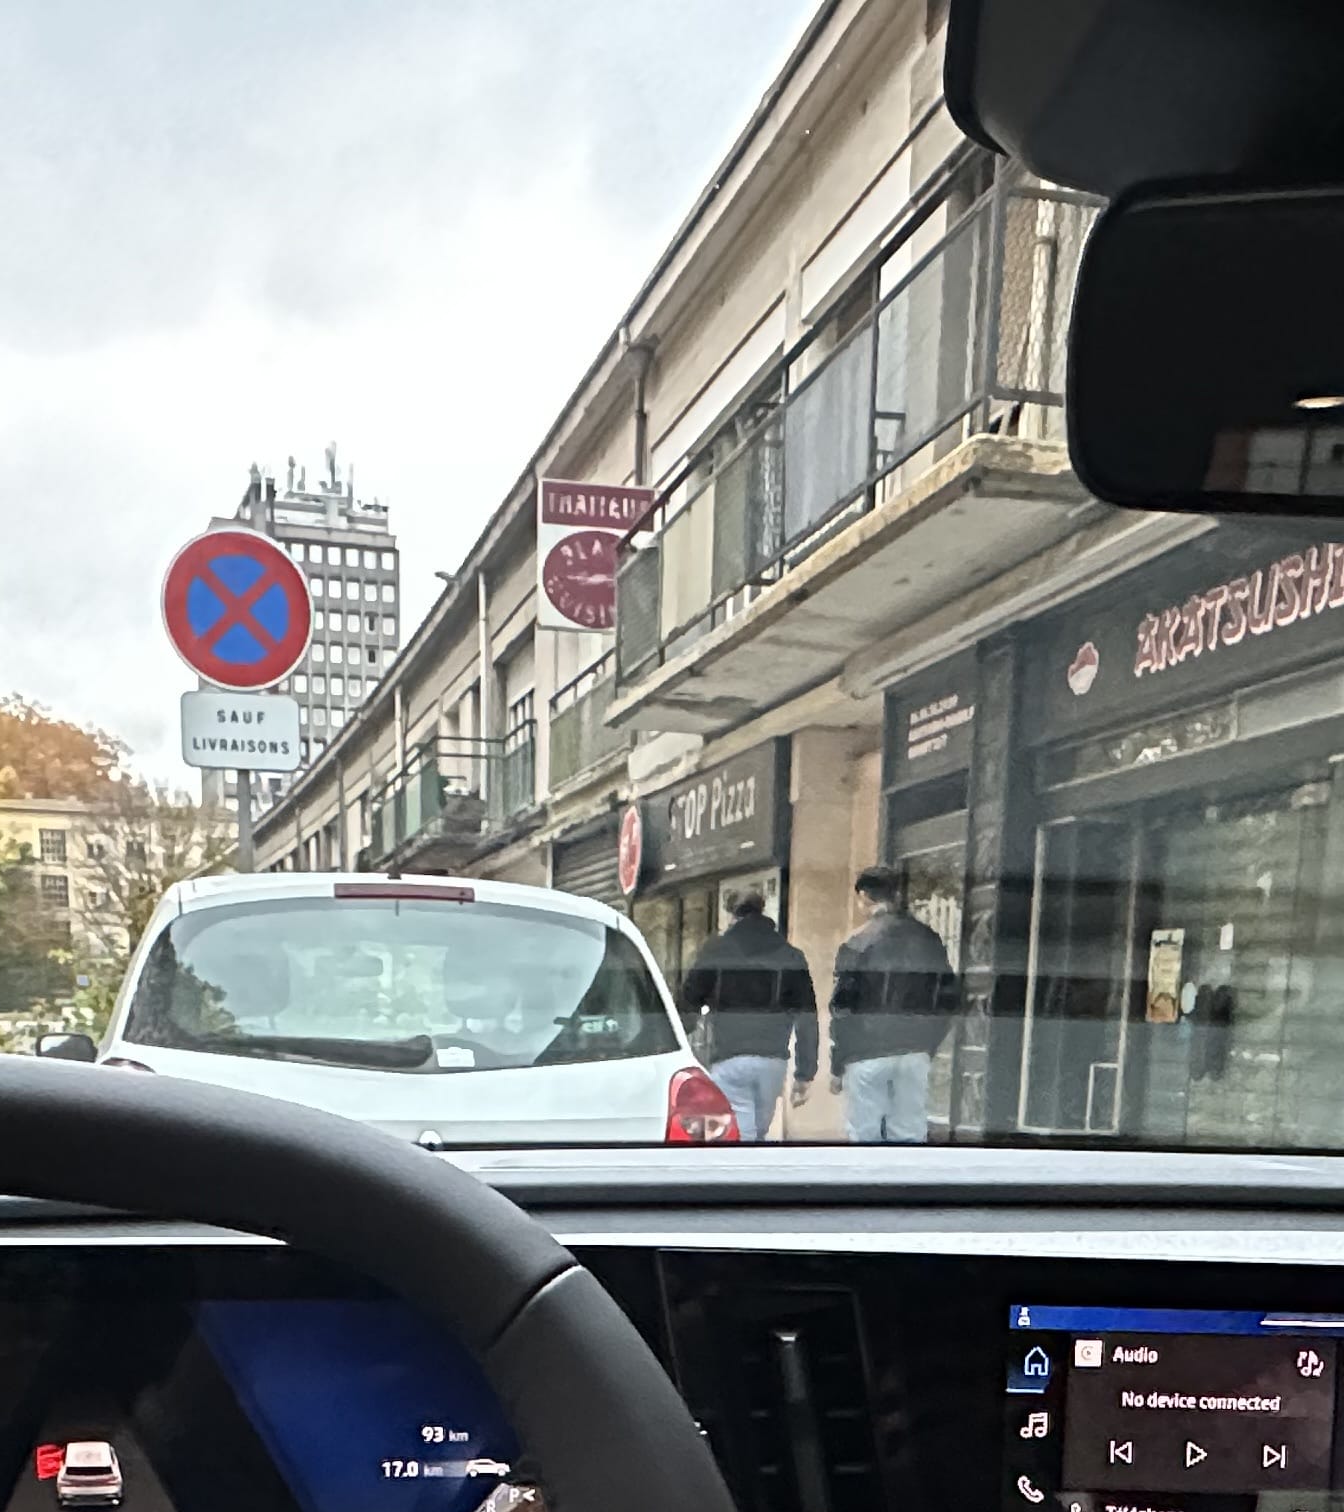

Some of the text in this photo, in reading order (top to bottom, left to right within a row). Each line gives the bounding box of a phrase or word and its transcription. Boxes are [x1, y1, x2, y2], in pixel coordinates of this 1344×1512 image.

[216, 709, 265, 724] SAUF
[192, 736, 290, 755] LIVRAISONS
[711, 770, 755, 830] Pizza
[1112, 1346, 1159, 1364] Audio
[1121, 1391, 1281, 1411] No device connected
[421, 1426, 469, 1443] 93 km
[381, 1461, 444, 1477] 17.0 km
[509, 1488, 519, 1503] P
